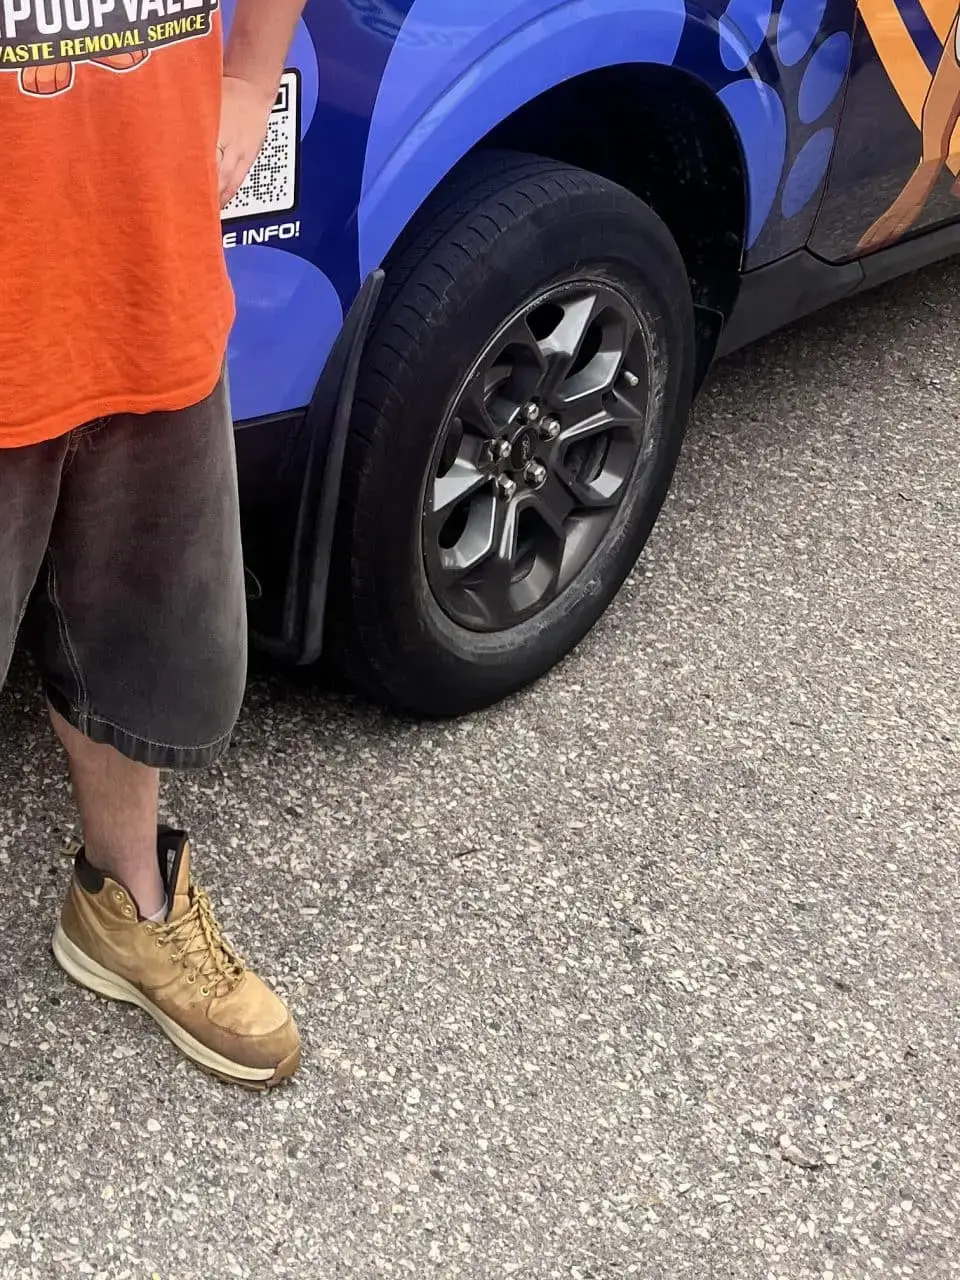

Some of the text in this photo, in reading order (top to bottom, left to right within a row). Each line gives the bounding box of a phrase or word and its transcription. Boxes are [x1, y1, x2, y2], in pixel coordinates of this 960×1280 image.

[61, 27, 144, 58] REMOVAL
[147, 14, 206, 43] SERVICE
[242, 220, 301, 246] INFO!
